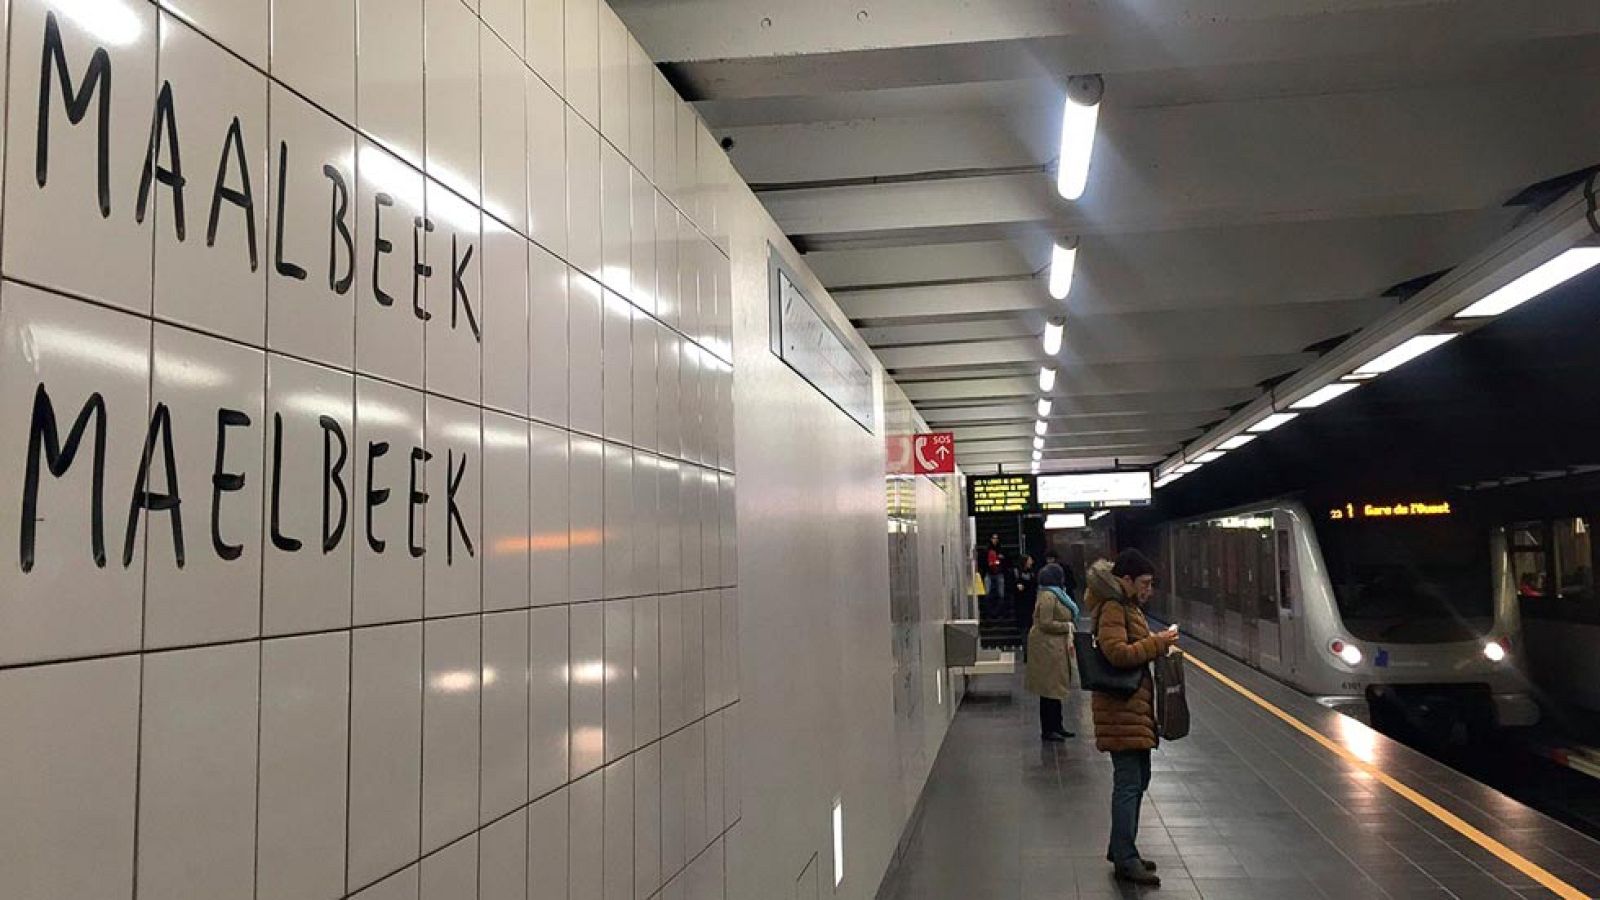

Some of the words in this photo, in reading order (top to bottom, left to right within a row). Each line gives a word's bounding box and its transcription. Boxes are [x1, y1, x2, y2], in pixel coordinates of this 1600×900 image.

[36, 10, 480, 342] MAALBEEK
[20, 383, 474, 572] MAELBEEK
[933, 435, 951, 445] SOS
[1346, 502, 1354, 518] 1
[1364, 504, 1392, 516] Gare
[1393, 503, 1409, 515] de
